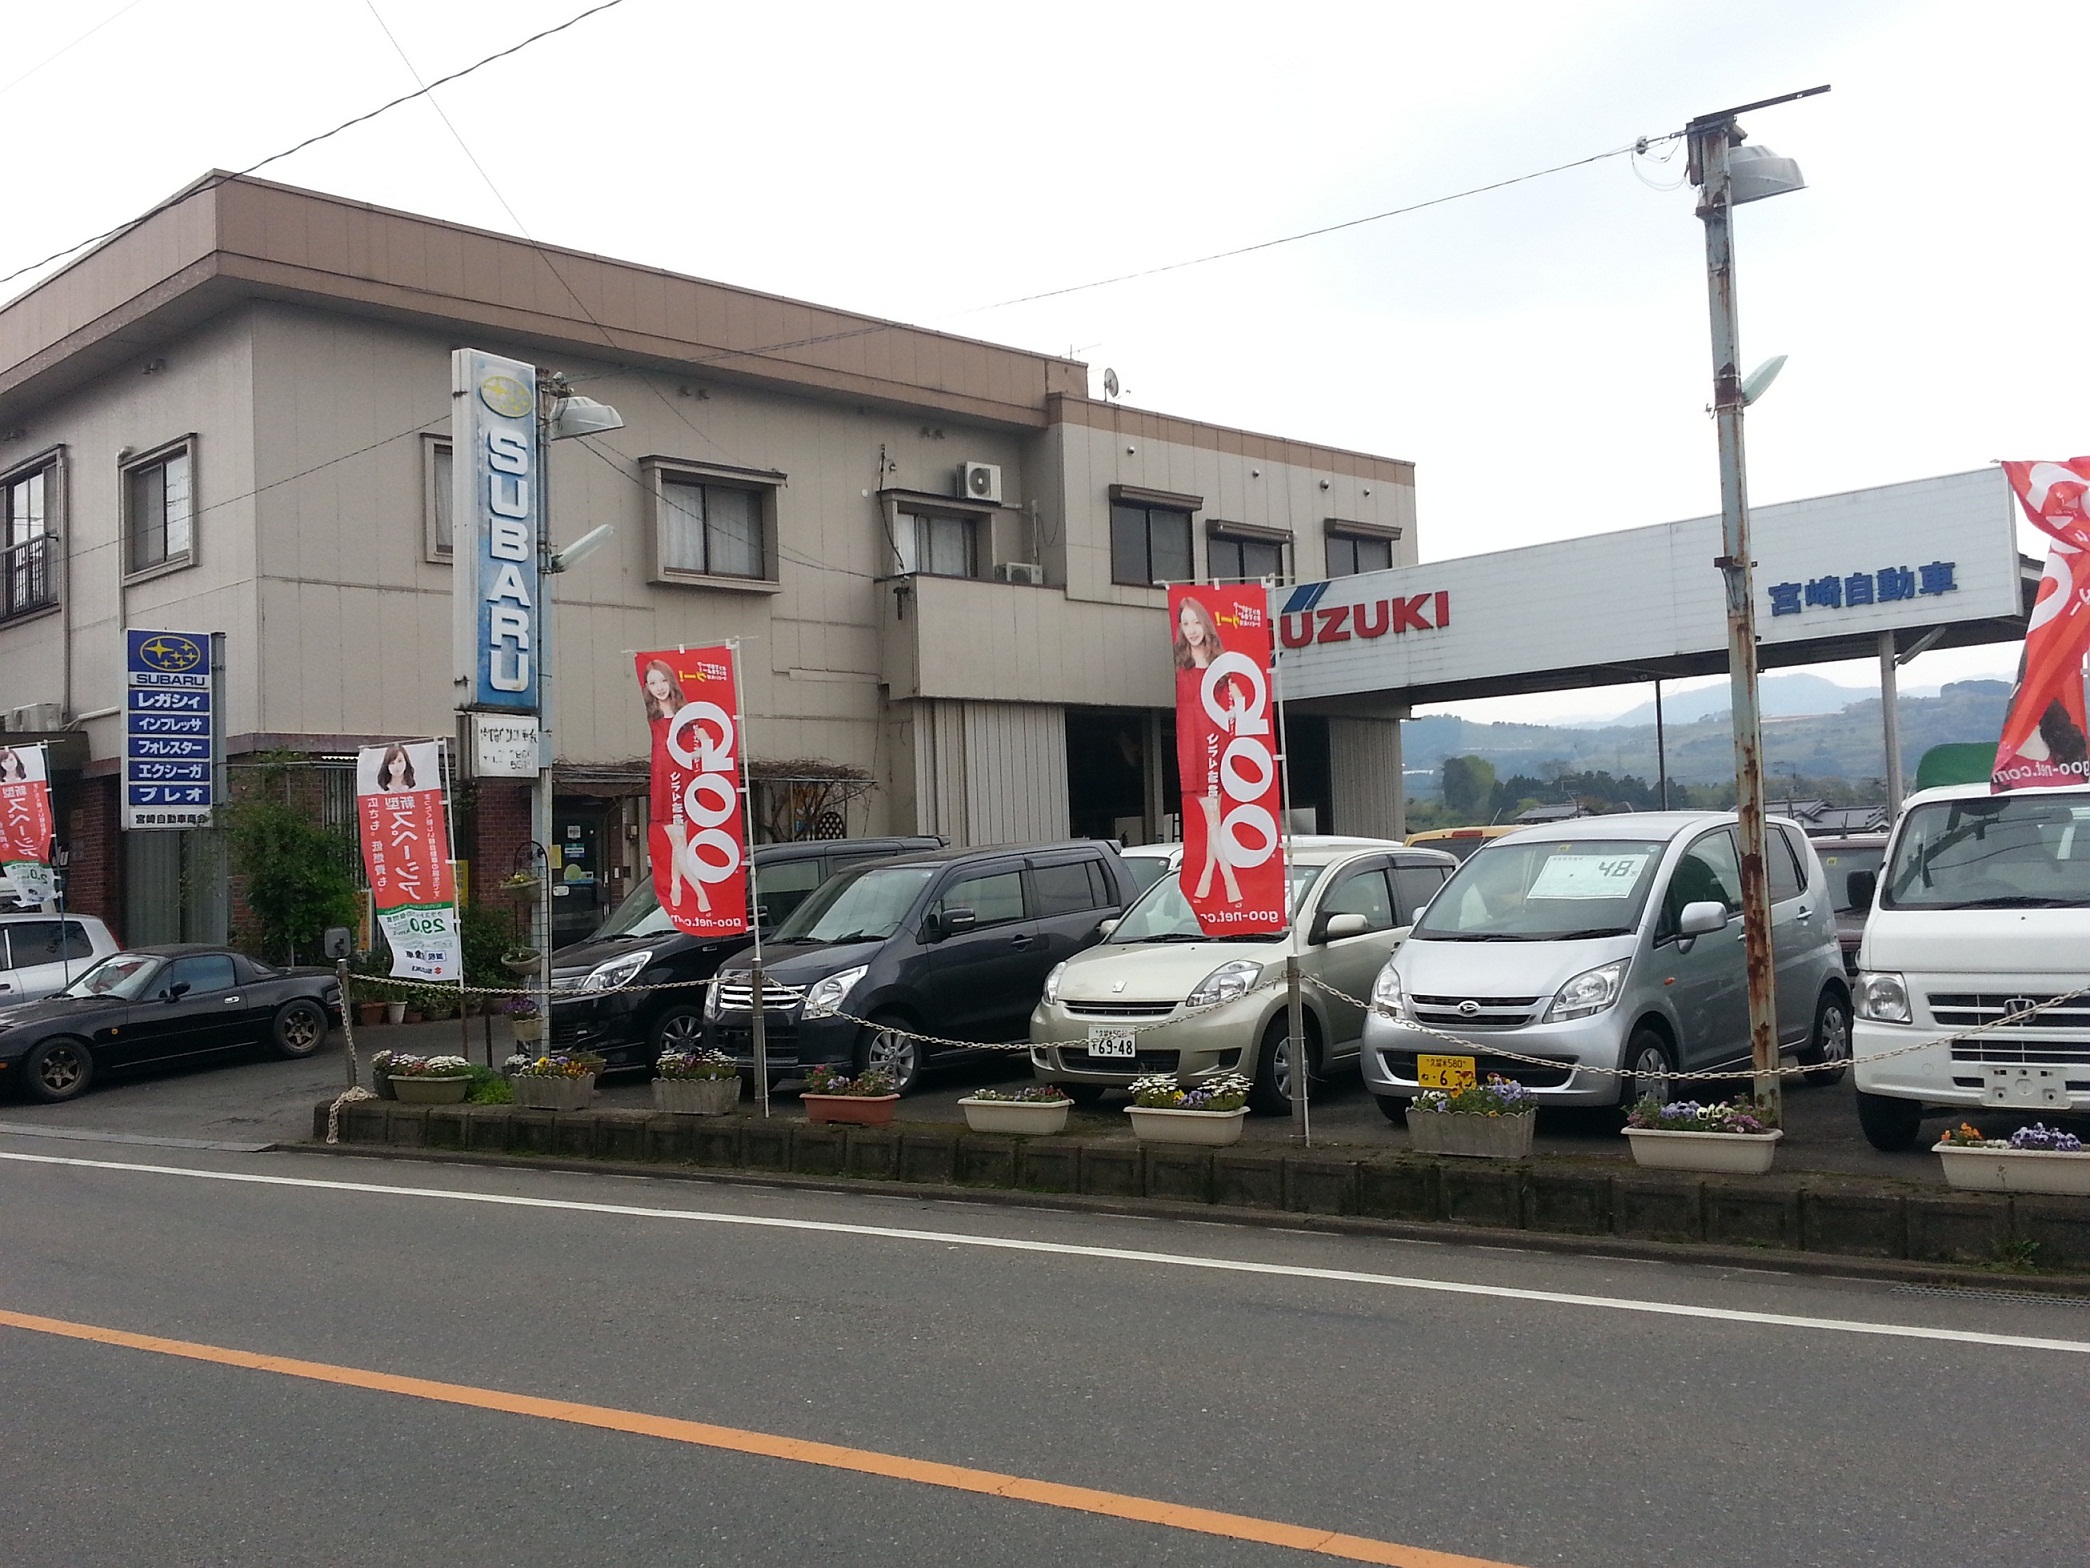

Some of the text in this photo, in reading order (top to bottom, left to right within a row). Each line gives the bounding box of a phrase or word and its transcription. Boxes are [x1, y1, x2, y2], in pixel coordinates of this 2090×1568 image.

[486, 427, 531, 692] SUBARU
[1768, 561, 1958, 617] 宮崎自動車
[1267, 590, 1450, 651] UZUKI
[136, 673, 205, 686] SUBARU
[138, 692, 201, 709] レガシィ
[138, 717, 202, 732] インプレッサ
[138, 741, 203, 755] フォレスター
[138, 764, 202, 779] エクシーガ
[138, 787, 203, 802] プレオ
[1598, 860, 1635, 877] 48
[1099, 1040, 1133, 1055] 69-48
